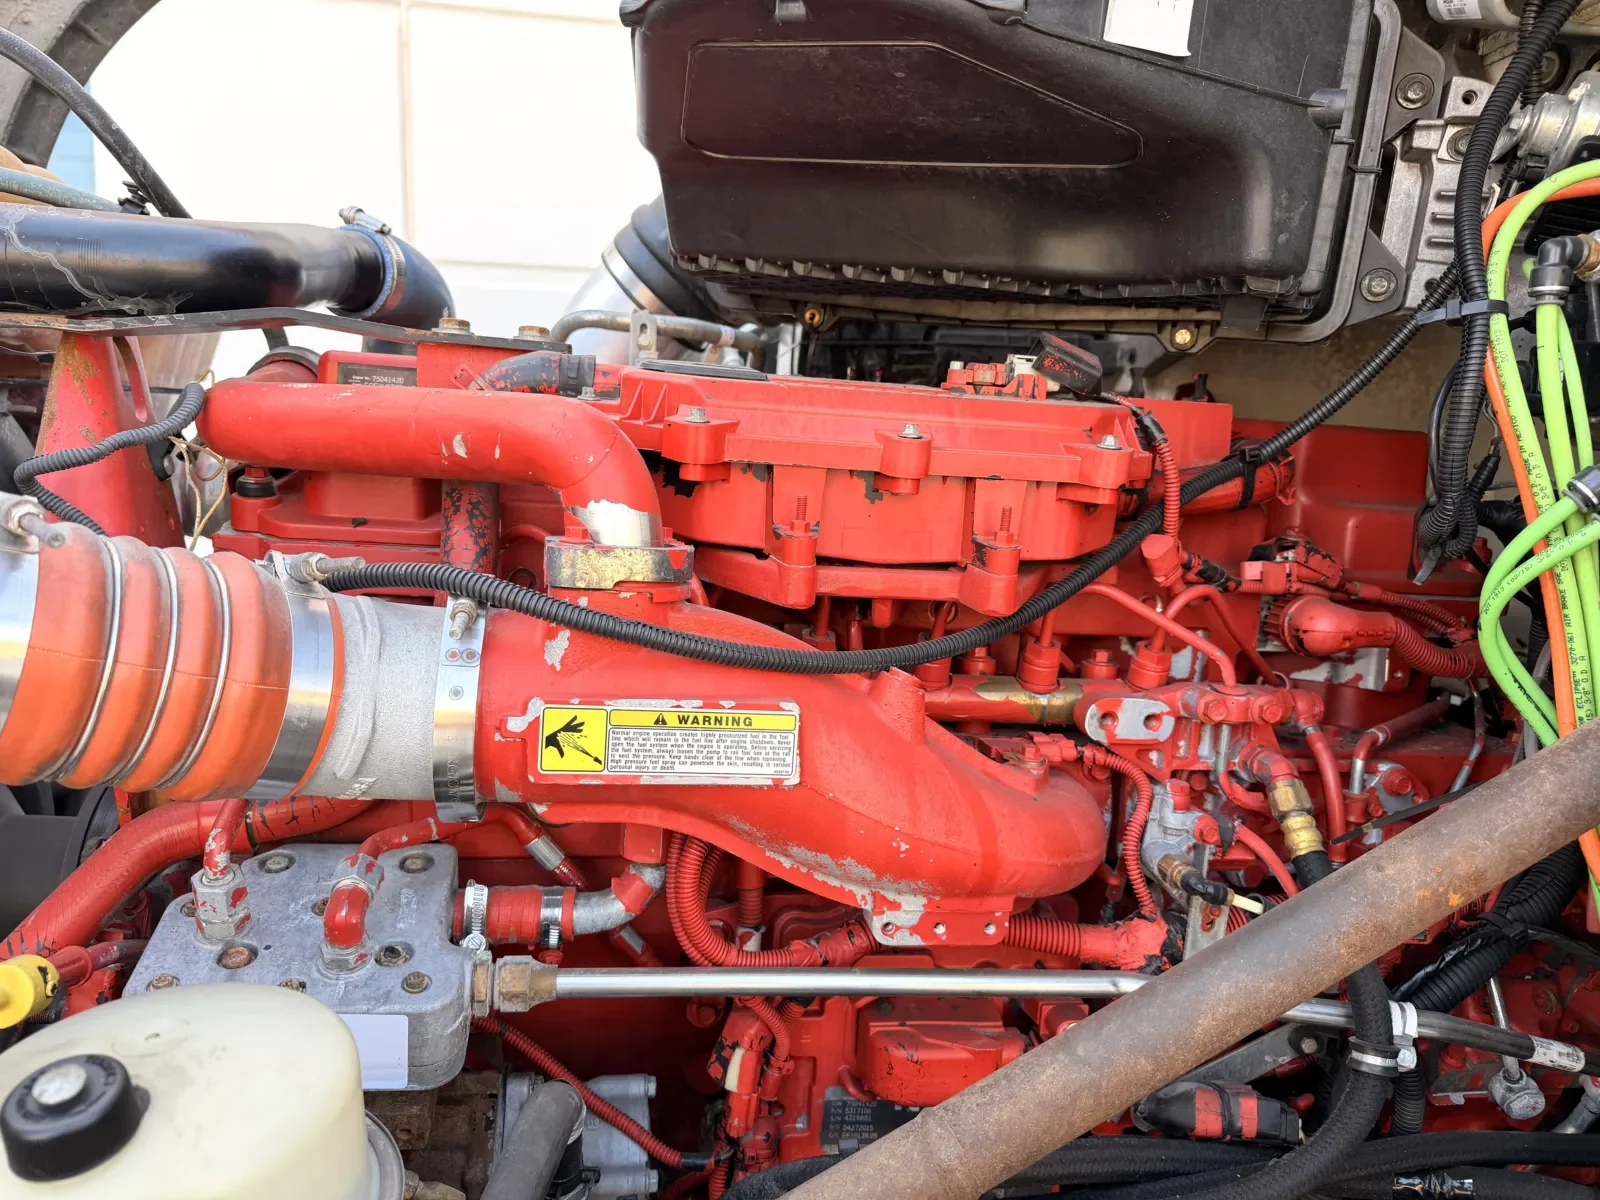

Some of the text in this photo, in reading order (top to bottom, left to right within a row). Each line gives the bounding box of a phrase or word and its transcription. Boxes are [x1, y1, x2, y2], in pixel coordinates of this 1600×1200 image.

[372, 376, 404, 384] 75041420
[1510, 415, 1523, 441] MEXICO
[1523, 458, 1533, 476] MADE
[1554, 572, 1563, 584] SAE
[1559, 589, 1568, 610] BRAKE
[1564, 613, 1572, 627] AIR
[1568, 632, 1578, 665] 3270-061
[678, 714, 752, 727] WARNING
